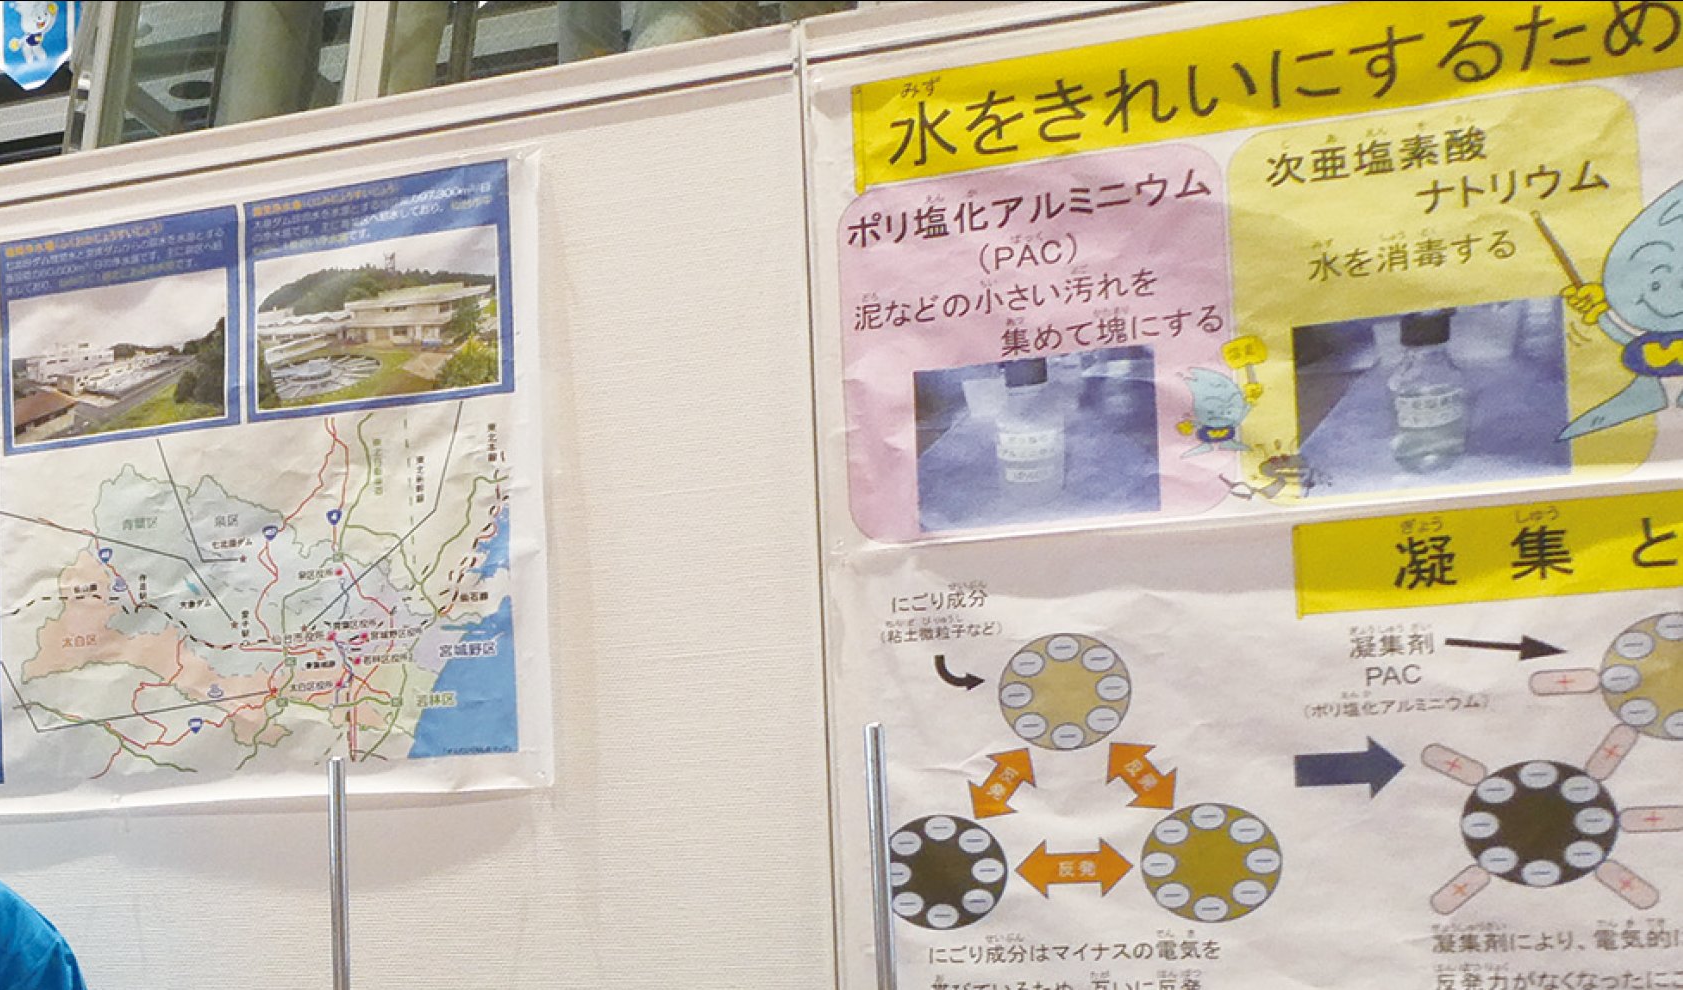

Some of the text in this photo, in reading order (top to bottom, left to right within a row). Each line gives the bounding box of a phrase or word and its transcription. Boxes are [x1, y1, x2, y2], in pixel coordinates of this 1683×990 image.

[888, 1, 1682, 166] 水をきれいにするため
[901, 77, 941, 97] みず
[1266, 125, 1487, 187] 次亜塩素酸
[847, 168, 1212, 248] ポリ塩化アルミニウム
[1415, 160, 1611, 215] ナトリウム
[1308, 230, 1517, 283] 水を消毒する
[854, 268, 1158, 332] 泥などの小さい汚れを
[1001, 304, 1224, 357] 集めて塊にする
[1399, 506, 1560, 535] ぎょう しゅう
[1392, 516, 1679, 590] 凝集と
[891, 589, 989, 614] にごり成分
[1348, 632, 1436, 660] 凝集剤
[1365, 664, 1422, 687] PAC
[1056, 859, 1099, 880] 反発
[929, 938, 1222, 966] にごり成分はマイナスの電気を
